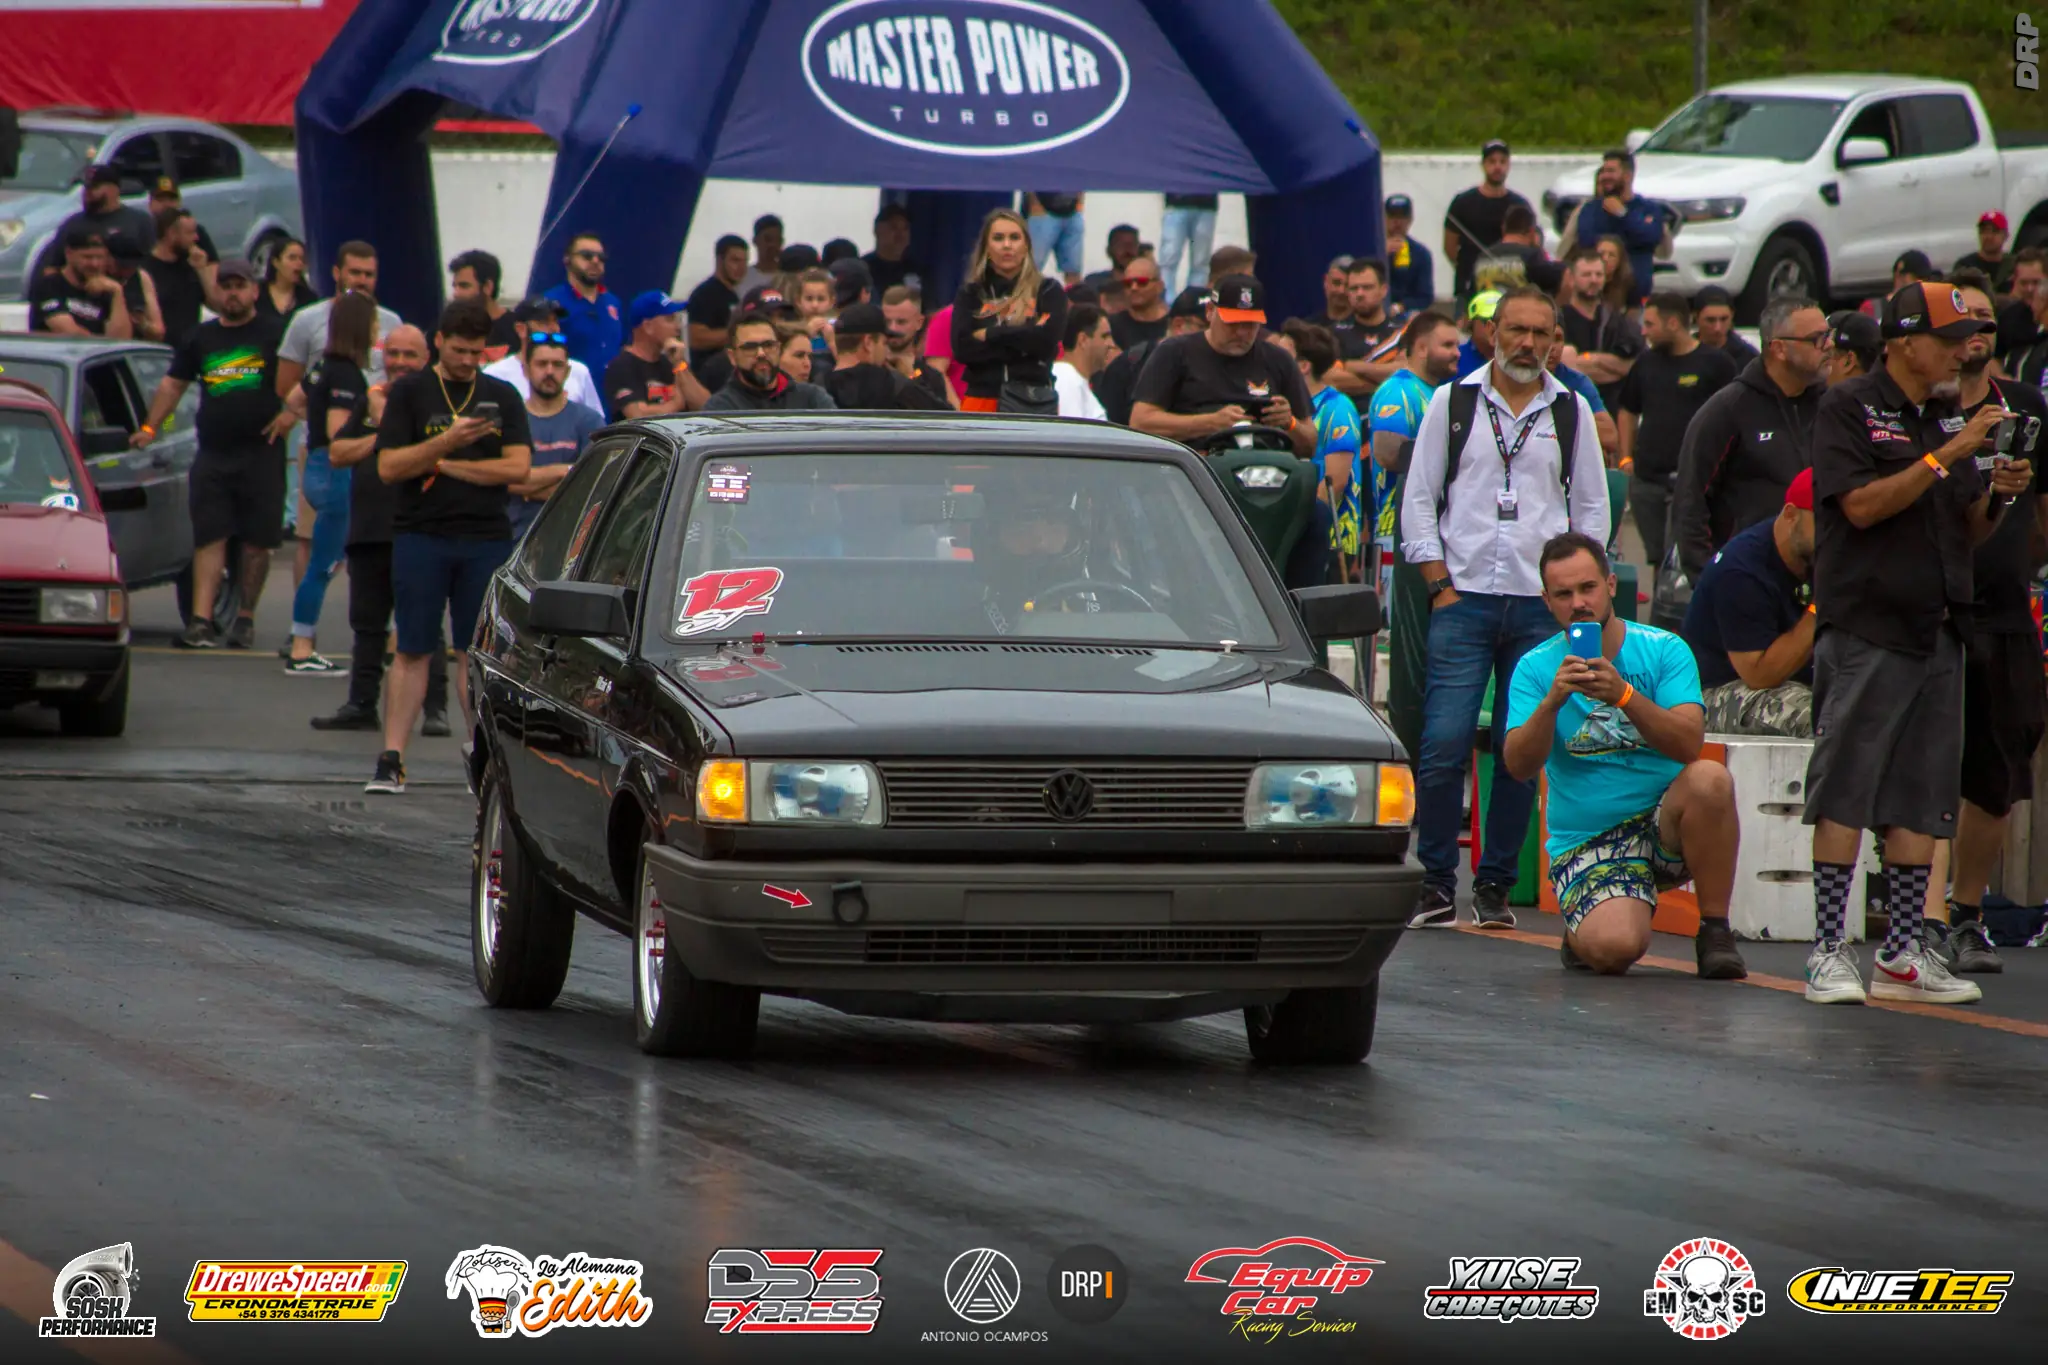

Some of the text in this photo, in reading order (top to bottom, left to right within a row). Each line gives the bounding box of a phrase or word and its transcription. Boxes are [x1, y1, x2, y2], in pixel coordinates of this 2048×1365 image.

[827, 16, 1101, 95] MASTER POWER
[889, 106, 1049, 126] TURBO
[681, 567, 782, 620] 12
[675, 603, 770, 636] ST
